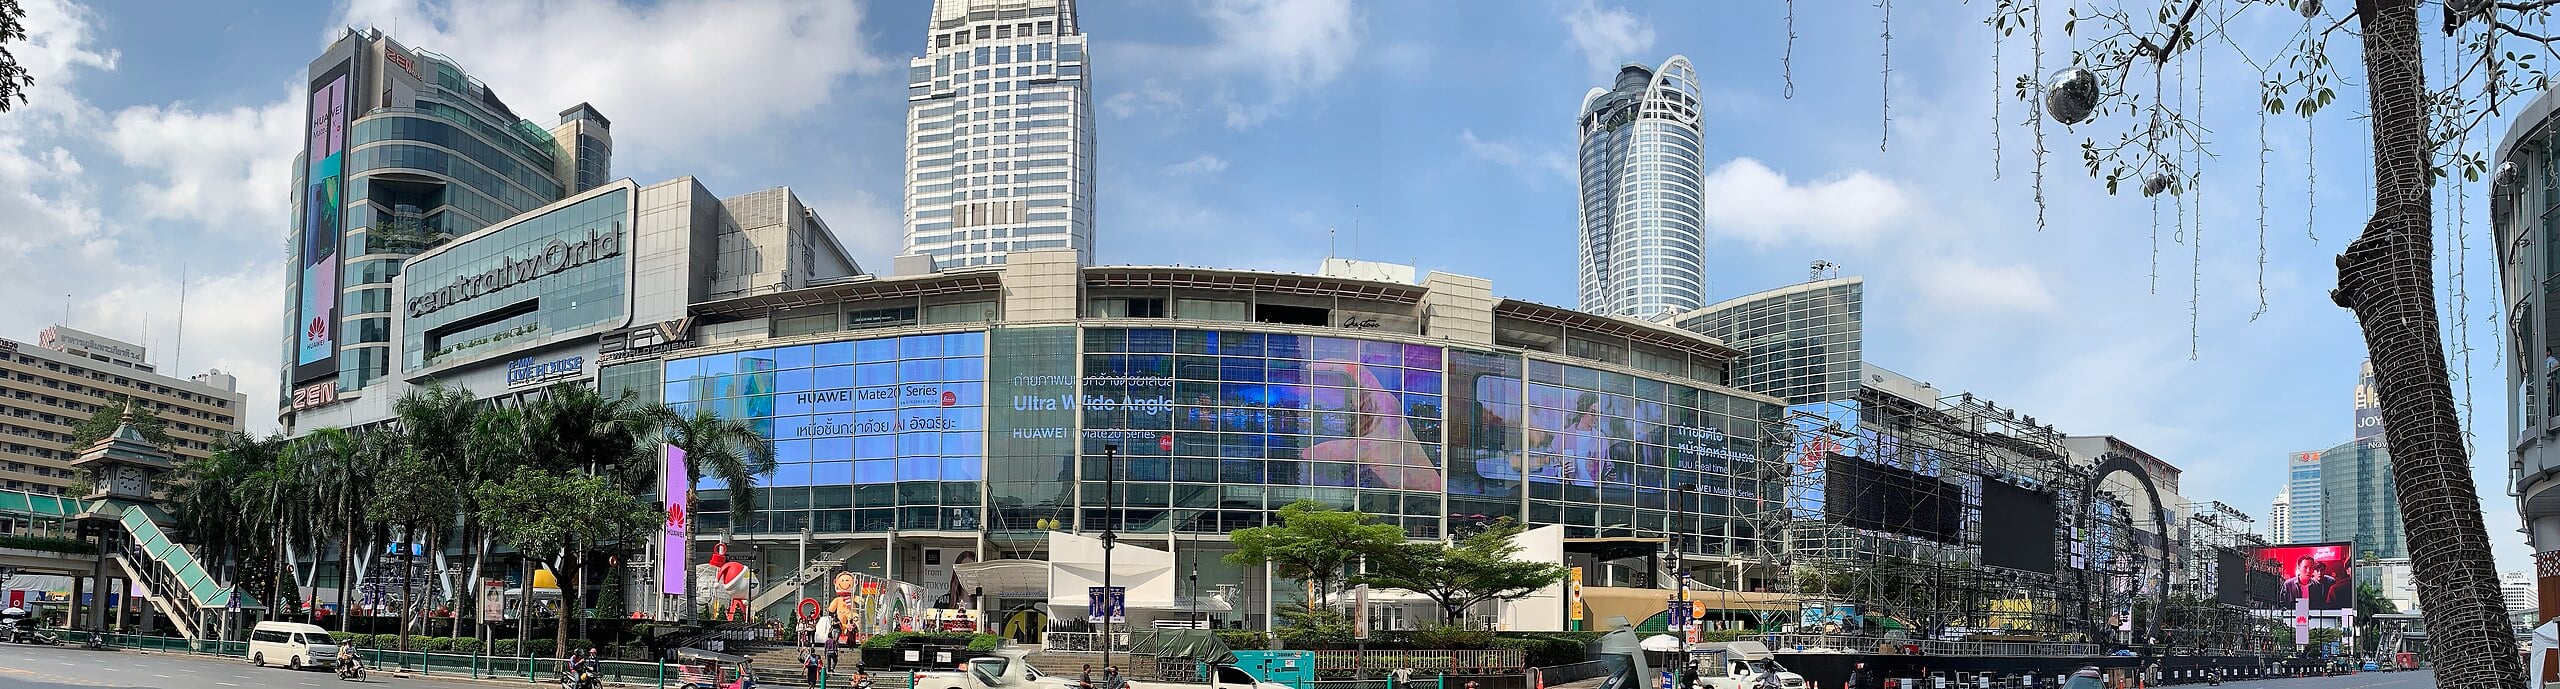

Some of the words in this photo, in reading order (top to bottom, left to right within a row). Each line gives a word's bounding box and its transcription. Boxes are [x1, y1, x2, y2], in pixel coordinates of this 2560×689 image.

[385, 46, 415, 71] ZEN
[306, 339, 325, 350] HUAWEI
[612, 346, 650, 360] WORLD
[651, 340, 696, 355] CINEMA
[507, 367, 534, 383] LIVE
[292, 381, 336, 410] ZEN
[797, 390, 852, 405] HUAWEI
[858, 388, 901, 401] Mate20
[906, 385, 938, 397] Series
[1014, 395, 1056, 411] Ultra
[1062, 394, 1115, 411] Wide
[1120, 395, 1174, 415] Angle
[892, 418, 905, 432] AI
[1013, 428, 1067, 439] HUAWEI
[1126, 429, 1156, 439] Series
[1713, 464, 1728, 474] time
[667, 529, 685, 538] HUAWEI
[925, 568, 942, 576] from
[925, 581, 949, 590] TOKYO
